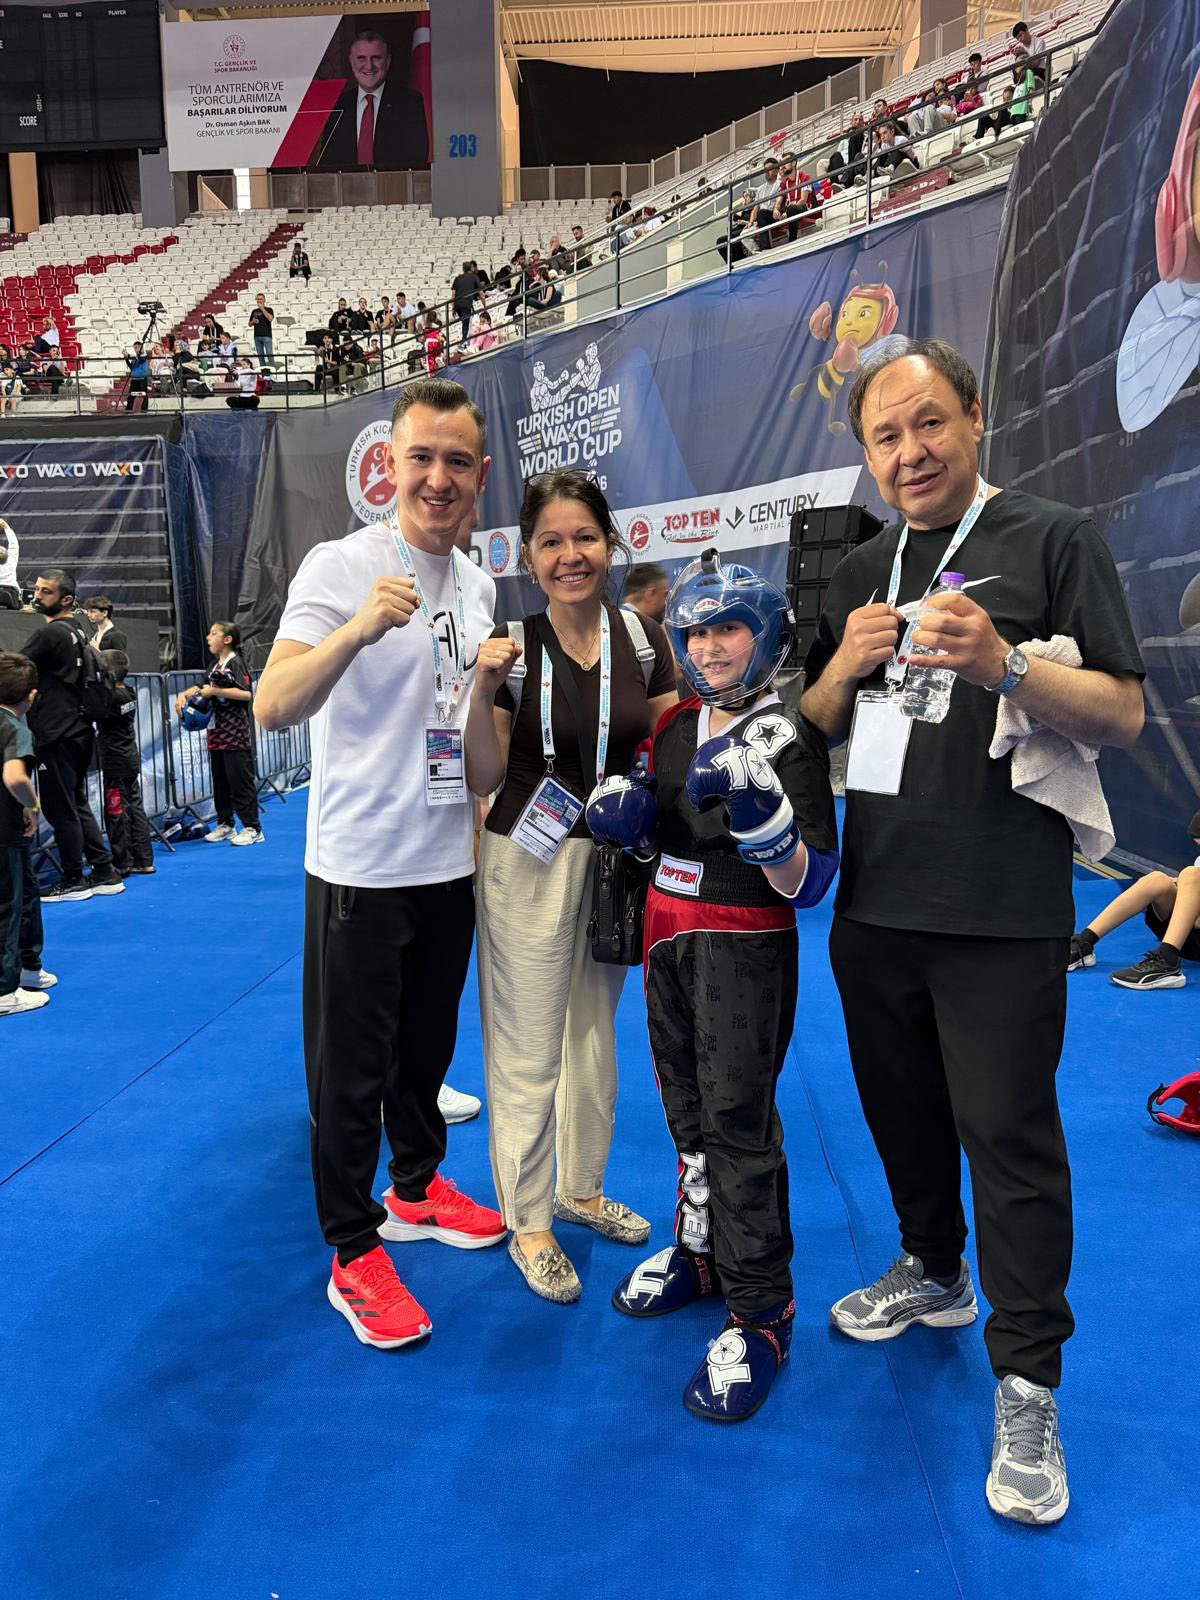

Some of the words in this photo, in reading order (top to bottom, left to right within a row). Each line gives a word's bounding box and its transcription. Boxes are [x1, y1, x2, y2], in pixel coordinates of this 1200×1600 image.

[188, 84, 212, 95] TÜM
[214, 81, 269, 94] ANTRENÖR
[272, 81, 284, 91] VE
[192, 92, 282, 106] SPORCULARIMIZA
[19, 115, 38, 126] SCORE
[187, 107, 236, 118] BAŞARILAR
[238, 105, 288, 114] DİLİYORUM
[449, 134, 477, 158] 203
[516, 400, 575, 438] TURKISH
[577, 384, 620, 417] OPEN
[541, 418, 591, 448] WAKO
[349, 430, 372, 482] TURKISH
[519, 442, 580, 479] WORLD
[582, 429, 622, 461] CUP
[36, 463, 87, 479] WAKO
[91, 462, 144, 477] WAKO
[664, 513, 690, 531] TOP
[690, 508, 720, 529] TEN
[749, 492, 820, 524] CENTURY
[753, 522, 785, 533] MARTIAL
[710, 745, 784, 792] TO
[752, 848, 776, 859] TOP
[680, 1152, 710, 1206] TOP
[707, 1327, 752, 1396] TO
